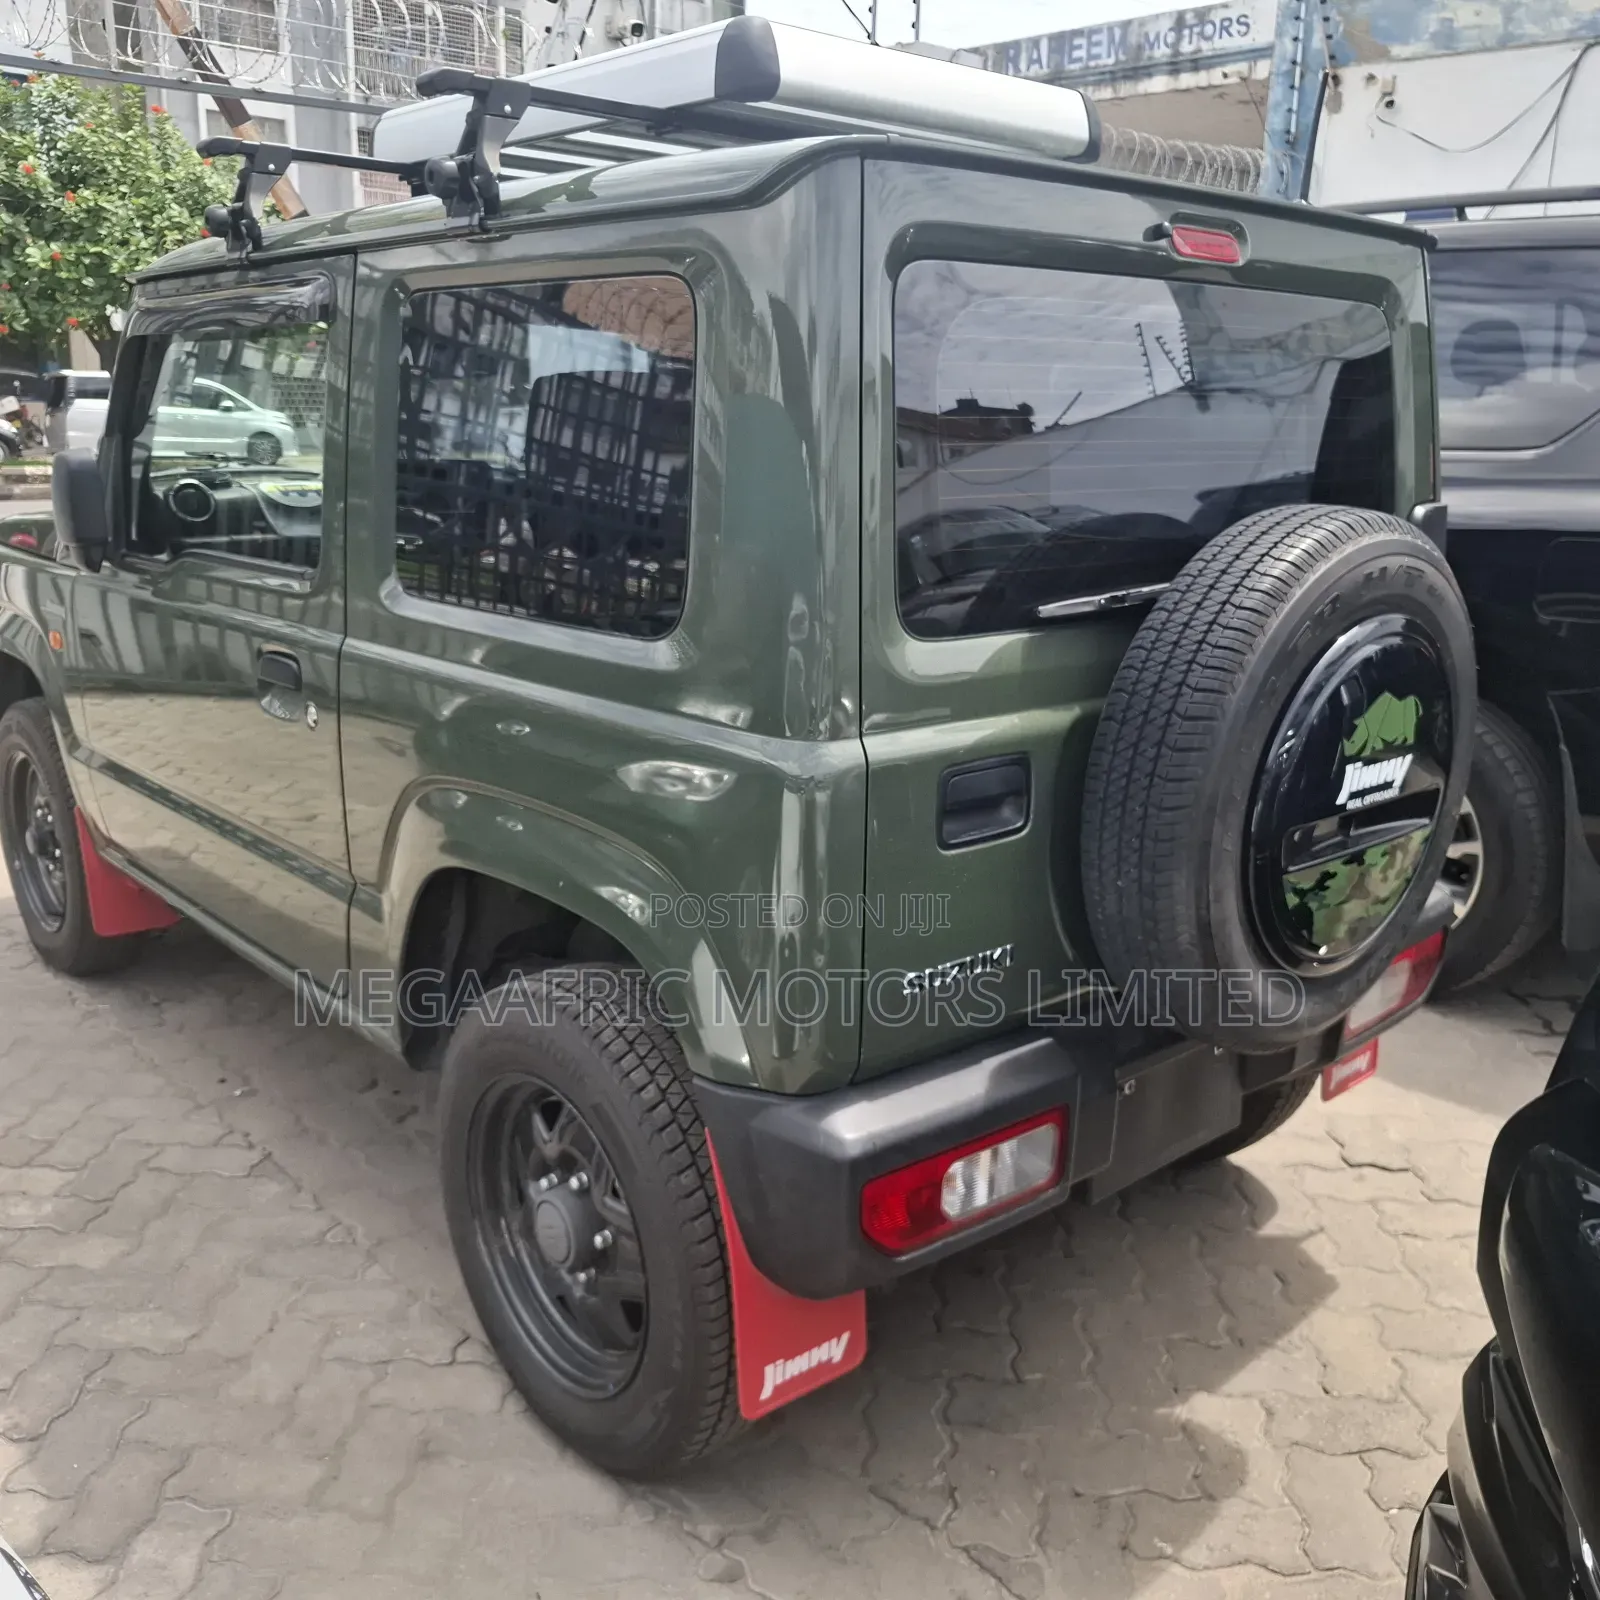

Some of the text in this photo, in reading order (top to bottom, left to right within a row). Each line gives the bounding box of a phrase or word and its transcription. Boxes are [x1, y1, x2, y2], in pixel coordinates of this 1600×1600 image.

[1144, 14, 1251, 51] MOTORS
[903, 943, 1014, 996] SUZUKI
[759, 1330, 851, 1401] Jimny
